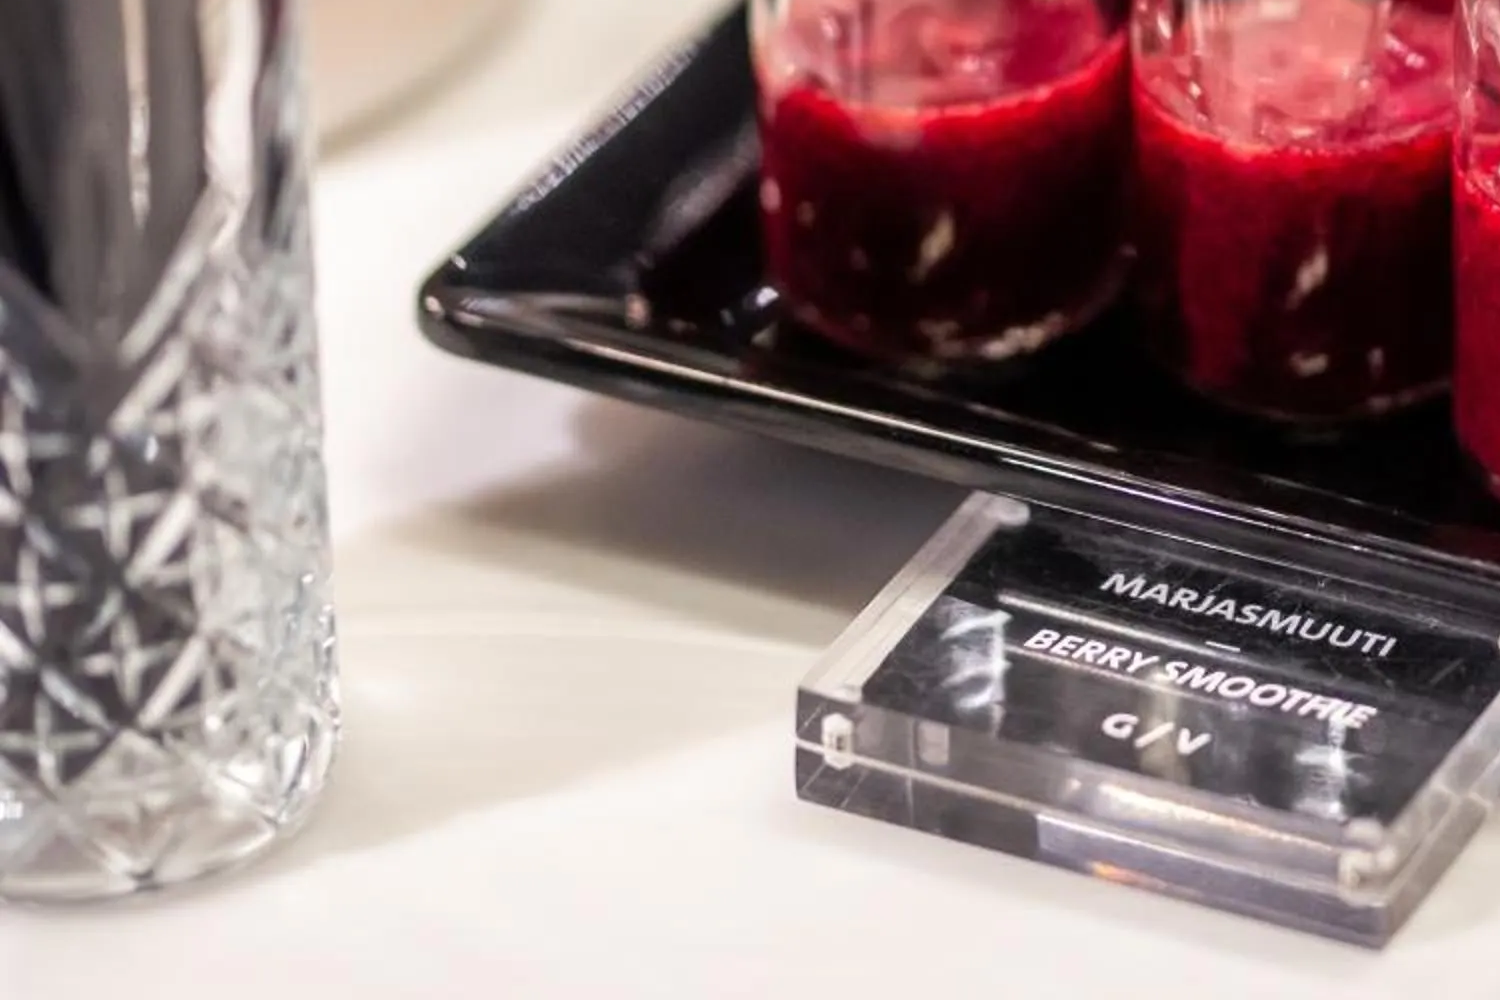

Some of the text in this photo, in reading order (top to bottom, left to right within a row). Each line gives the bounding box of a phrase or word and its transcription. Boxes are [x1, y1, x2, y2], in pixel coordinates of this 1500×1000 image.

[1100, 573, 1397, 657] MARJASMUUTI
[1023, 629, 1378, 729] BERRY SMOOTHIE
